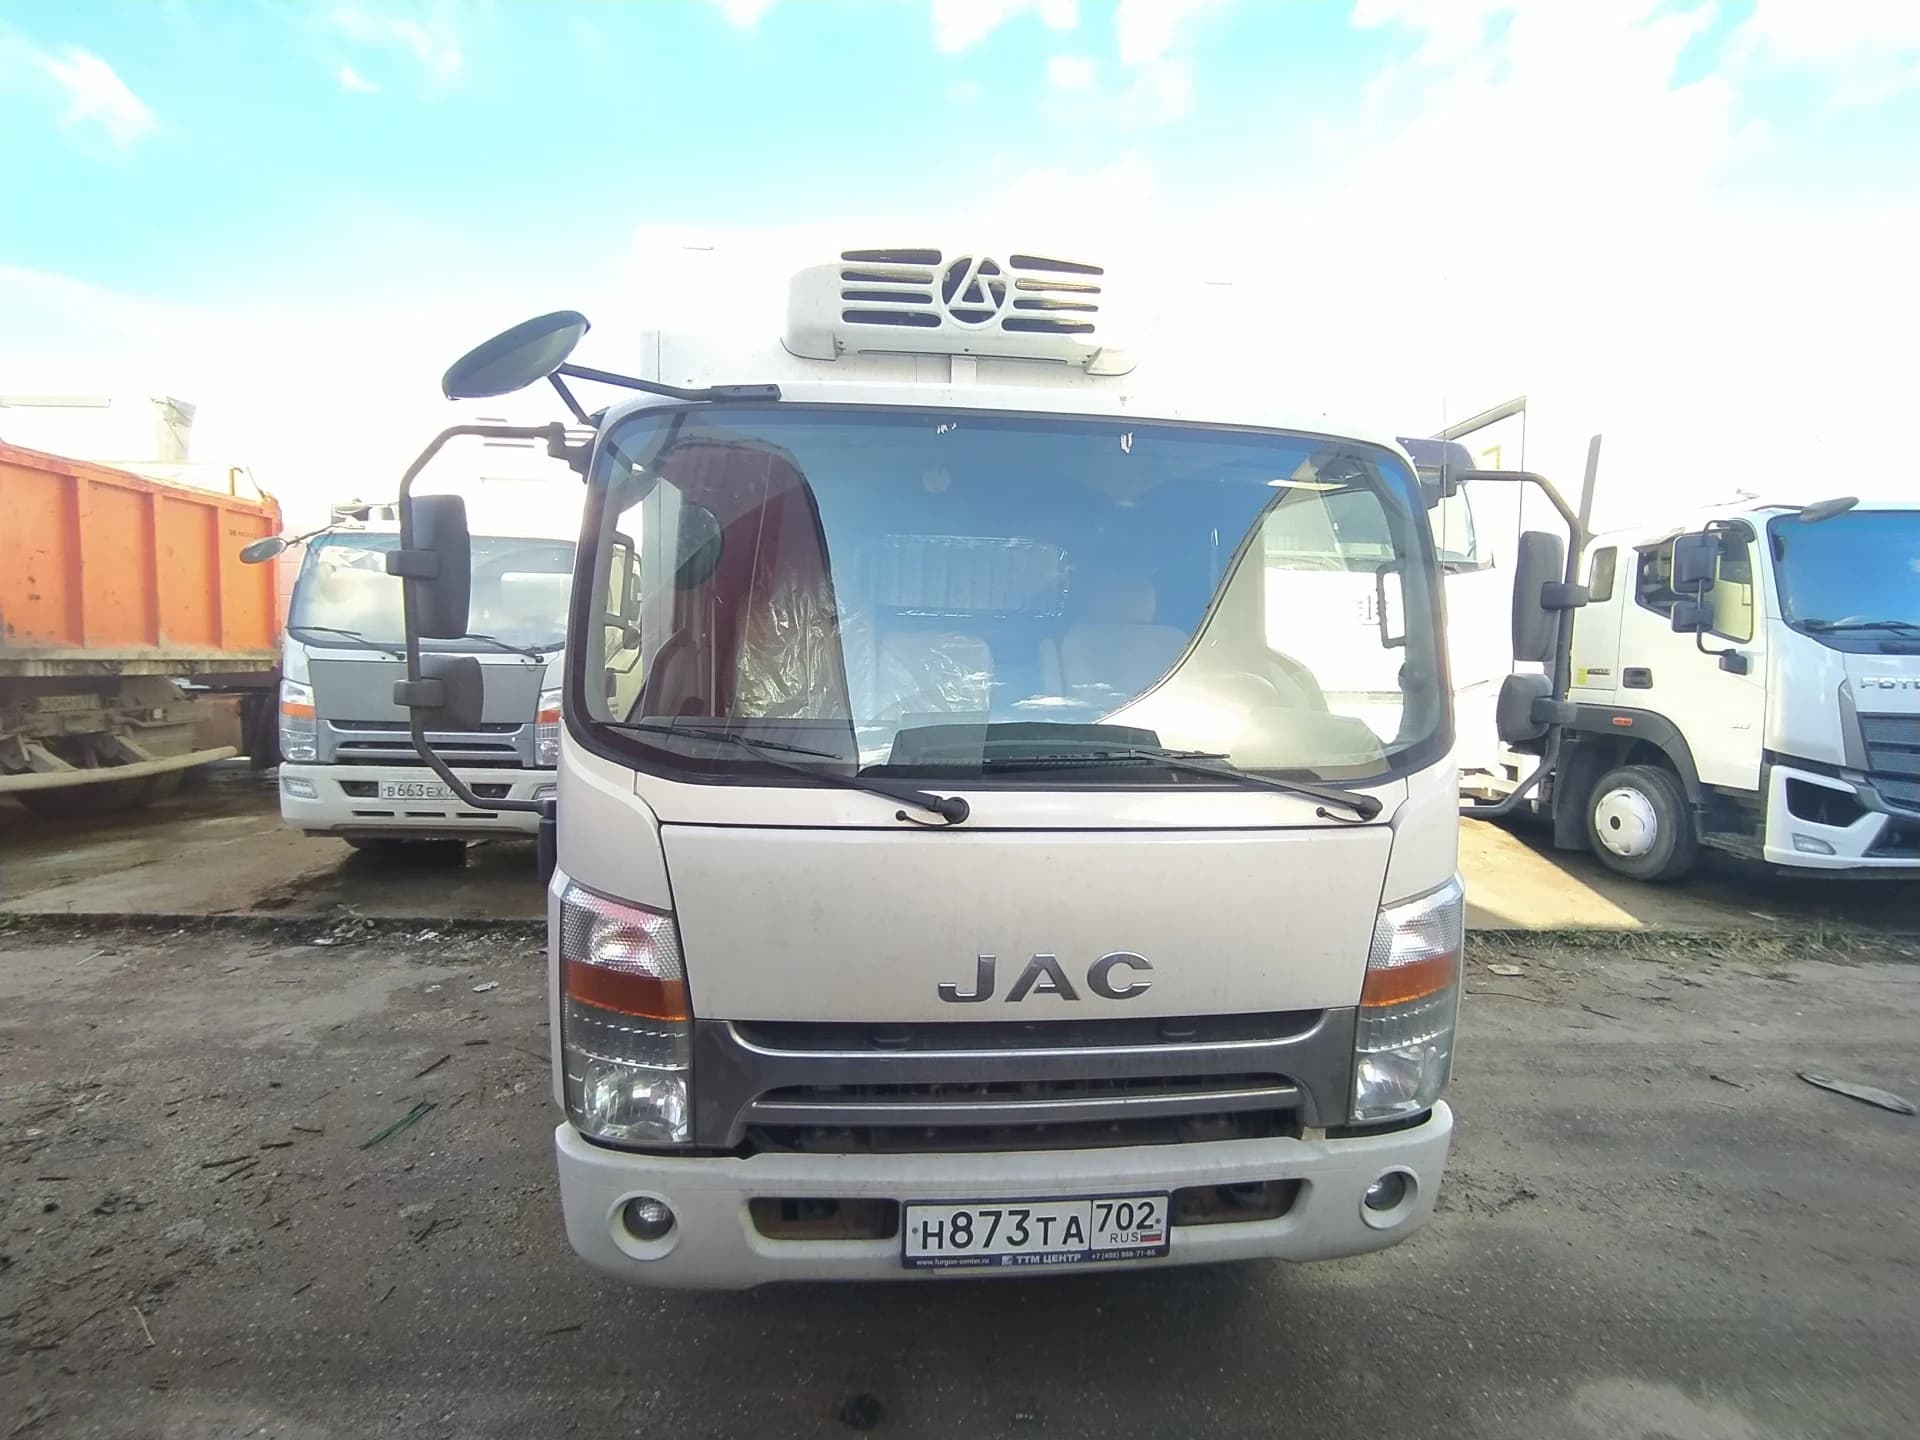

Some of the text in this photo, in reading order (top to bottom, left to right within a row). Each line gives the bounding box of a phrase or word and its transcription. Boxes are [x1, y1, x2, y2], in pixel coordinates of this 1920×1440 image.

[937, 951, 1154, 1003] JAC
[921, 1202, 1155, 1250] Н873ТА 702
[1110, 1232, 1139, 1243] RUS
[1043, 1253, 1081, 1265] ЦЕНТР
